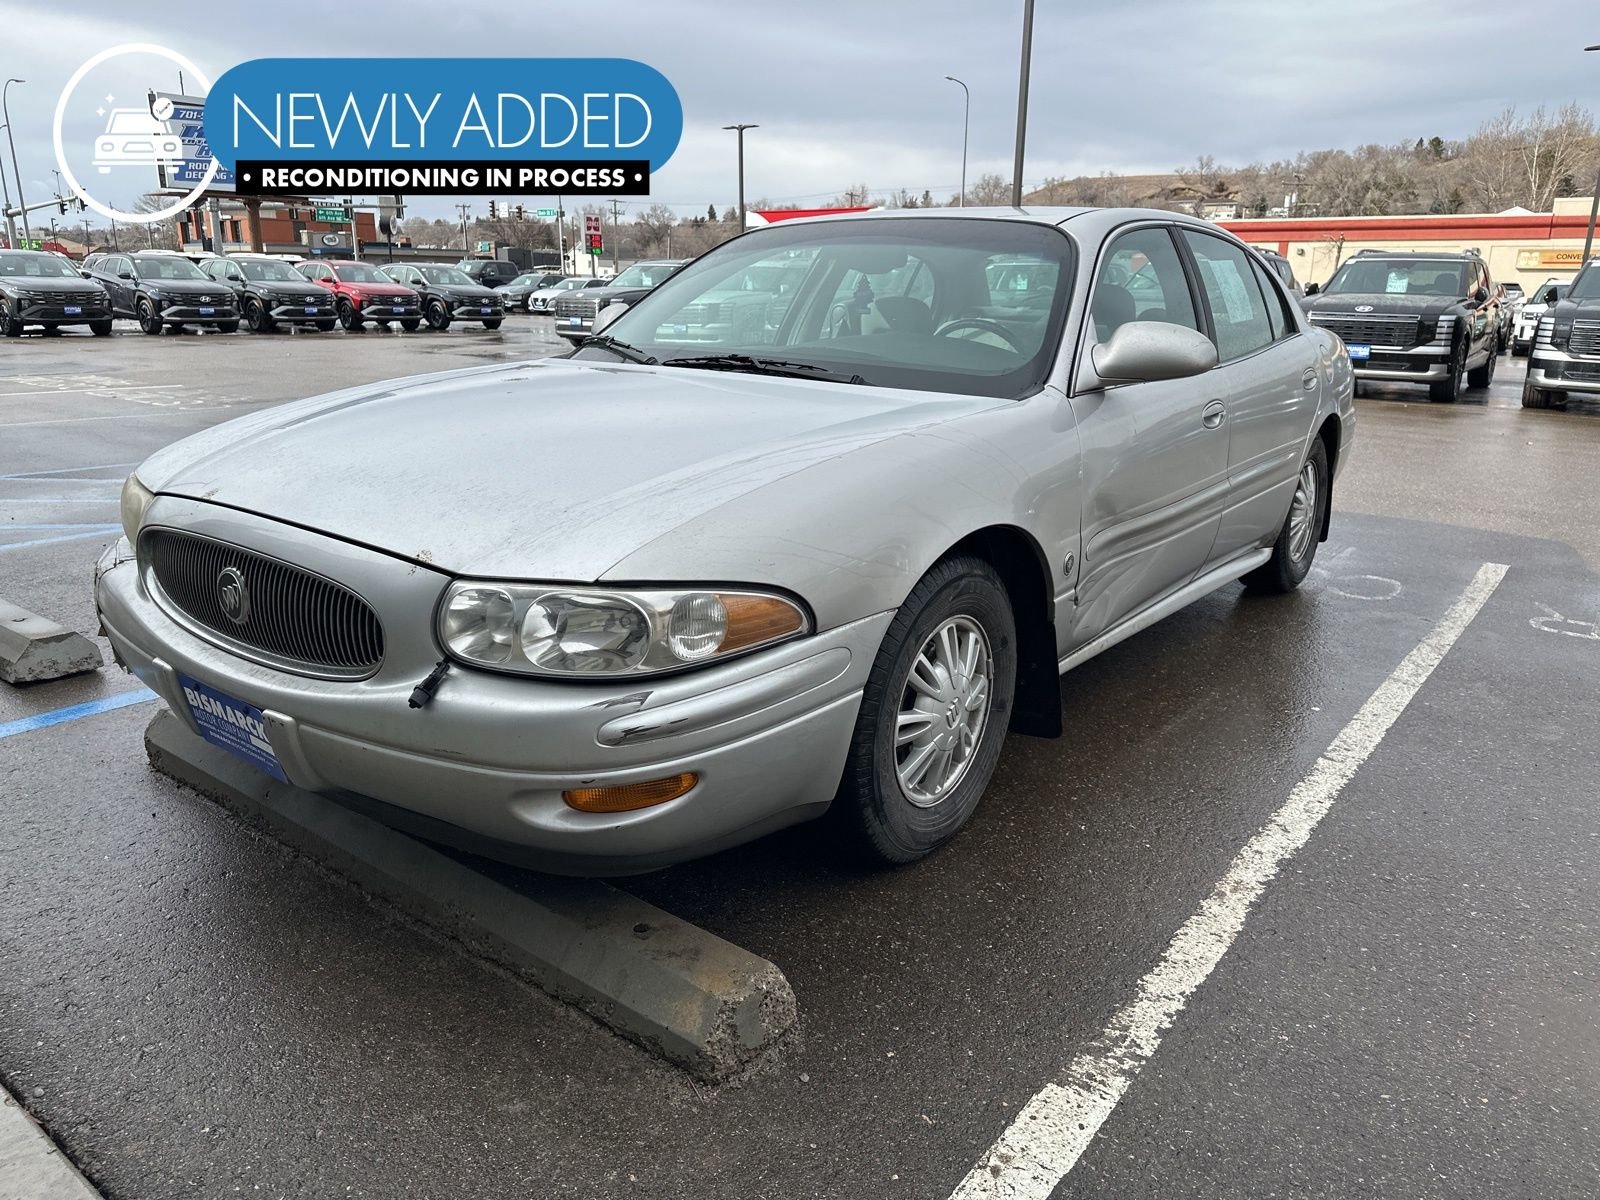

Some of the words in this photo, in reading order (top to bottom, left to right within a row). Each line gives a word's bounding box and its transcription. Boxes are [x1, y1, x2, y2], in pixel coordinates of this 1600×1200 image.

[183, 686, 271, 743] BISMARCK
[192, 707, 218, 726] MOTOR
[218, 718, 251, 744] COMPANY
